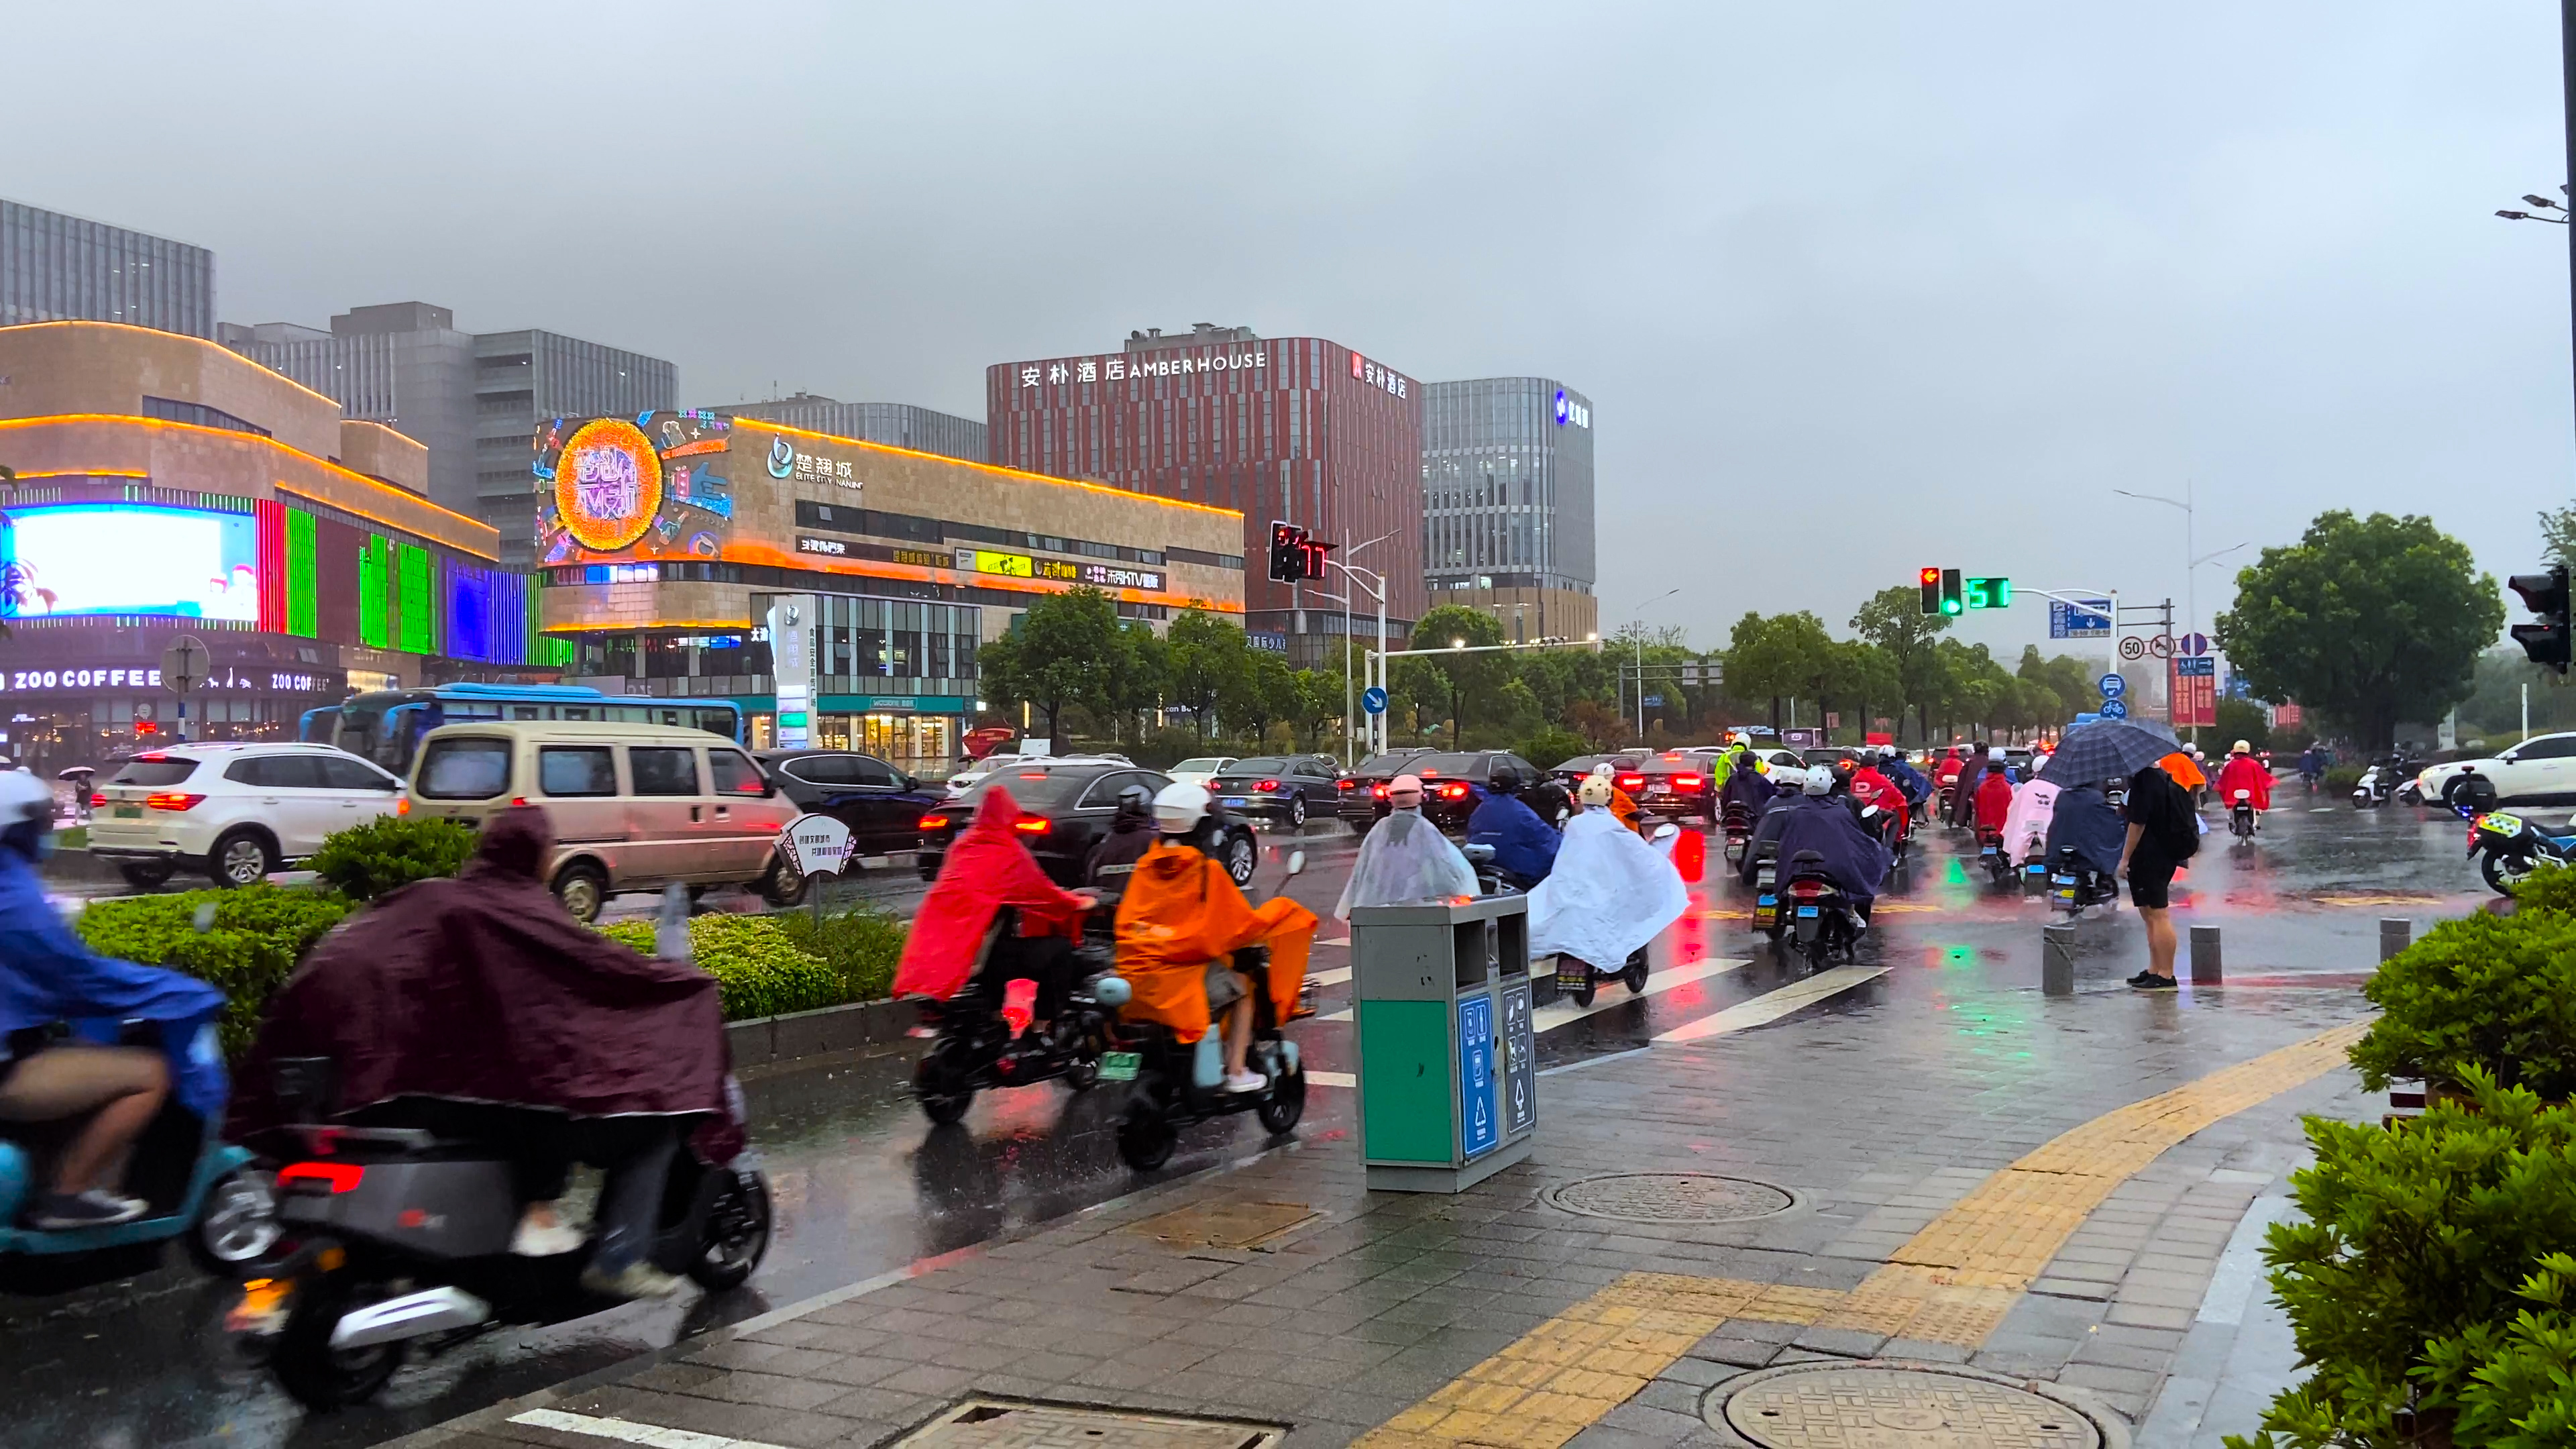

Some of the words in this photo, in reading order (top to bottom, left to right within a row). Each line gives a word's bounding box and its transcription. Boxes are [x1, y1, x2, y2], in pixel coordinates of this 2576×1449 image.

[1022, 359, 1124, 388] 安朴酒店
[1365, 362, 1406, 399] 安朴酒店
[796, 453, 852, 479] 楚翘城
[796, 472, 815, 482] ELITE
[816, 476, 832, 485] CITY
[836, 479, 863, 490] NANJING
[1969, 580, 2009, 608] 51
[2125, 641, 2140, 655] 50
[15, 671, 57, 689] ZOO
[62, 669, 162, 688] COFFEE
[272, 674, 291, 690] ZOO
[294, 675, 327, 692] COFFEE
